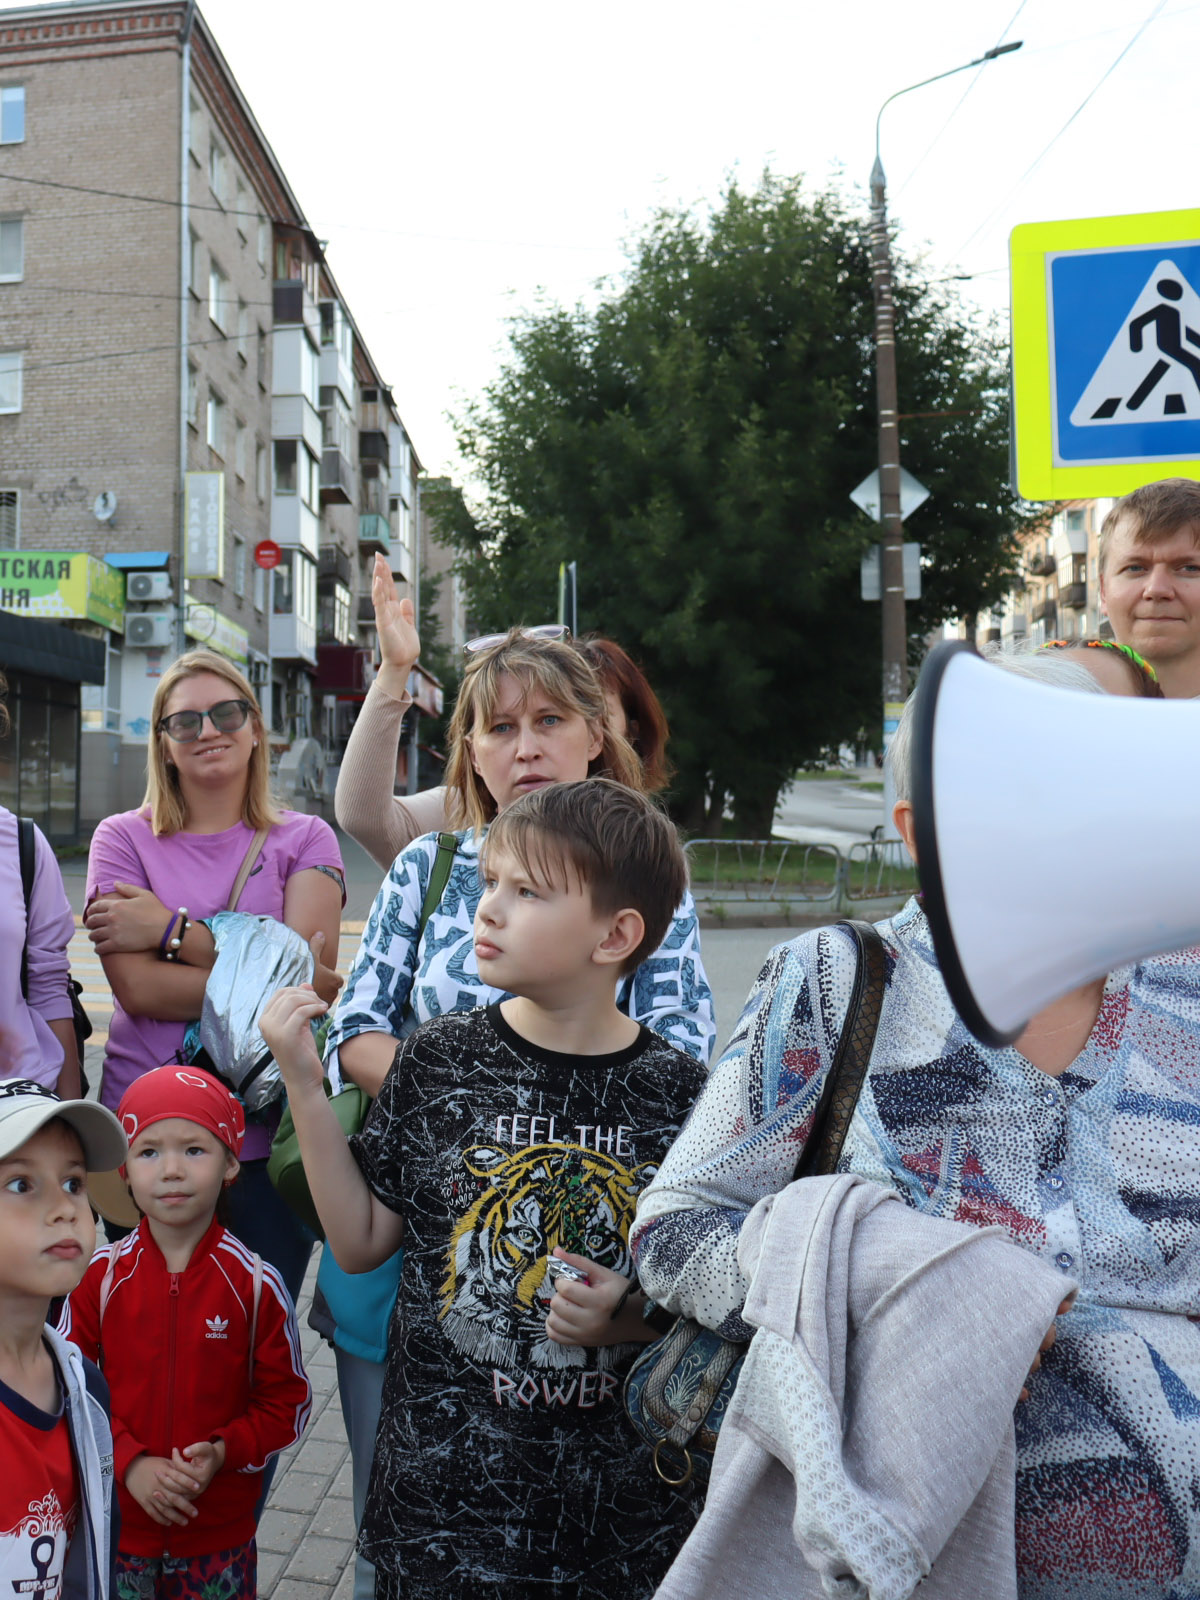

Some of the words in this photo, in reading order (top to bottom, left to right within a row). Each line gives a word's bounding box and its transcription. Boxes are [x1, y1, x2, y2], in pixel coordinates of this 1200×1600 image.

[496, 1114, 564, 1147] FEEL
[574, 1124, 634, 1156] THE
[493, 1369, 618, 1408] POWER
